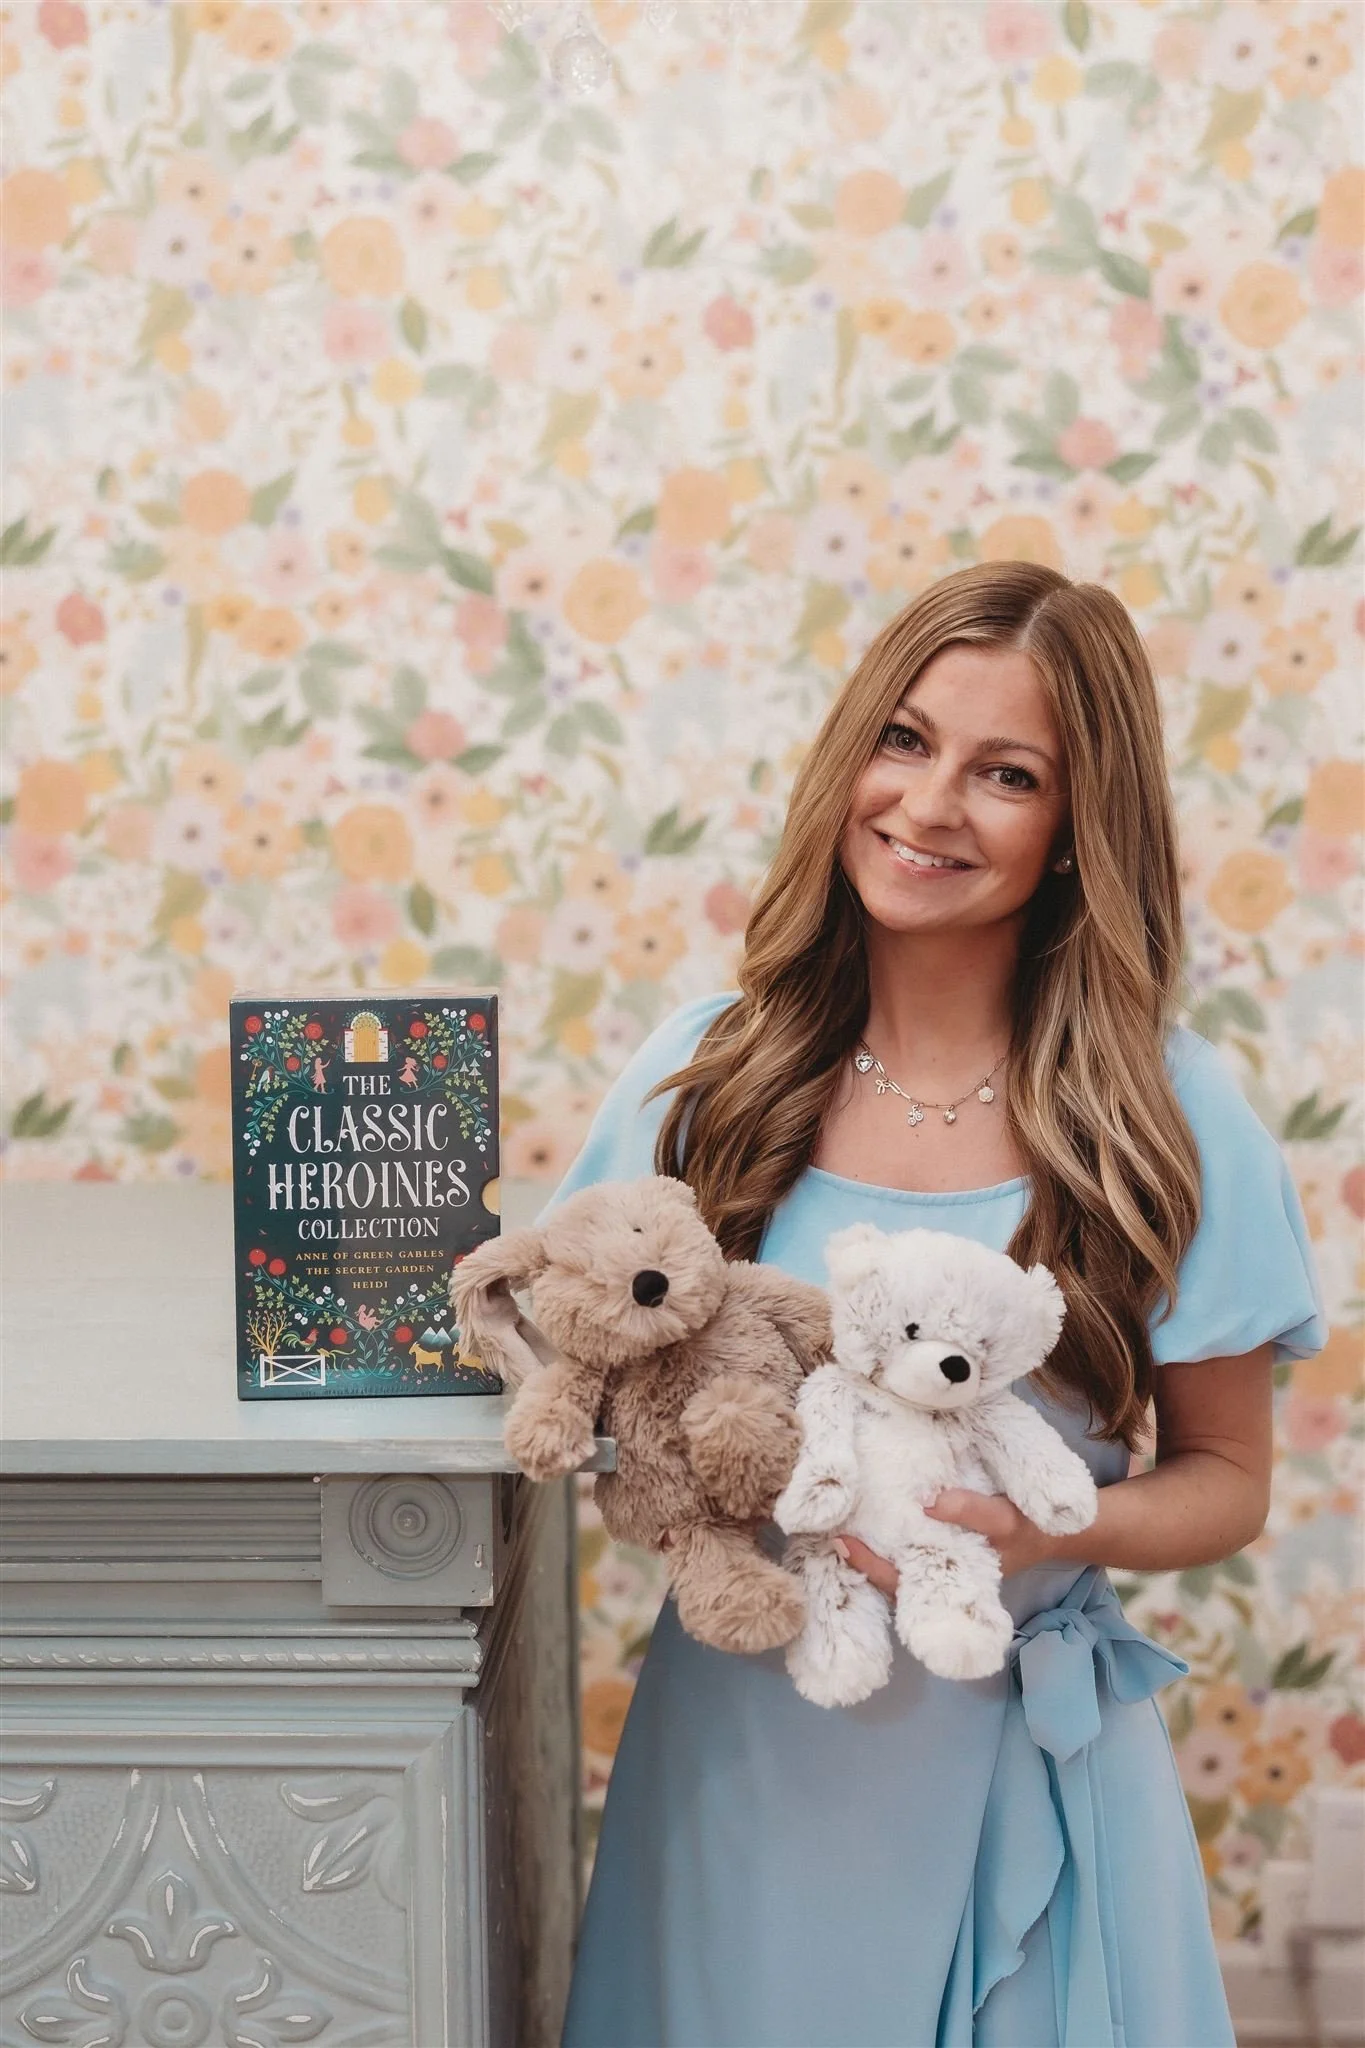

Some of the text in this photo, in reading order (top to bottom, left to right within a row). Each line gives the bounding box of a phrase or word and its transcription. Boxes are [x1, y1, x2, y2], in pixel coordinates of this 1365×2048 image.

[343, 1075, 391, 1096] THE
[287, 1103, 449, 1153] CLASSIC
[267, 1159, 471, 1210] HEROINES
[298, 1217, 440, 1240] COLLECTION
[295, 1249, 444, 1261] ANNE OF GREEN GABLES
[305, 1264, 435, 1276] THE SECRET GARDEN
[352, 1281, 389, 1289] HEIDI
